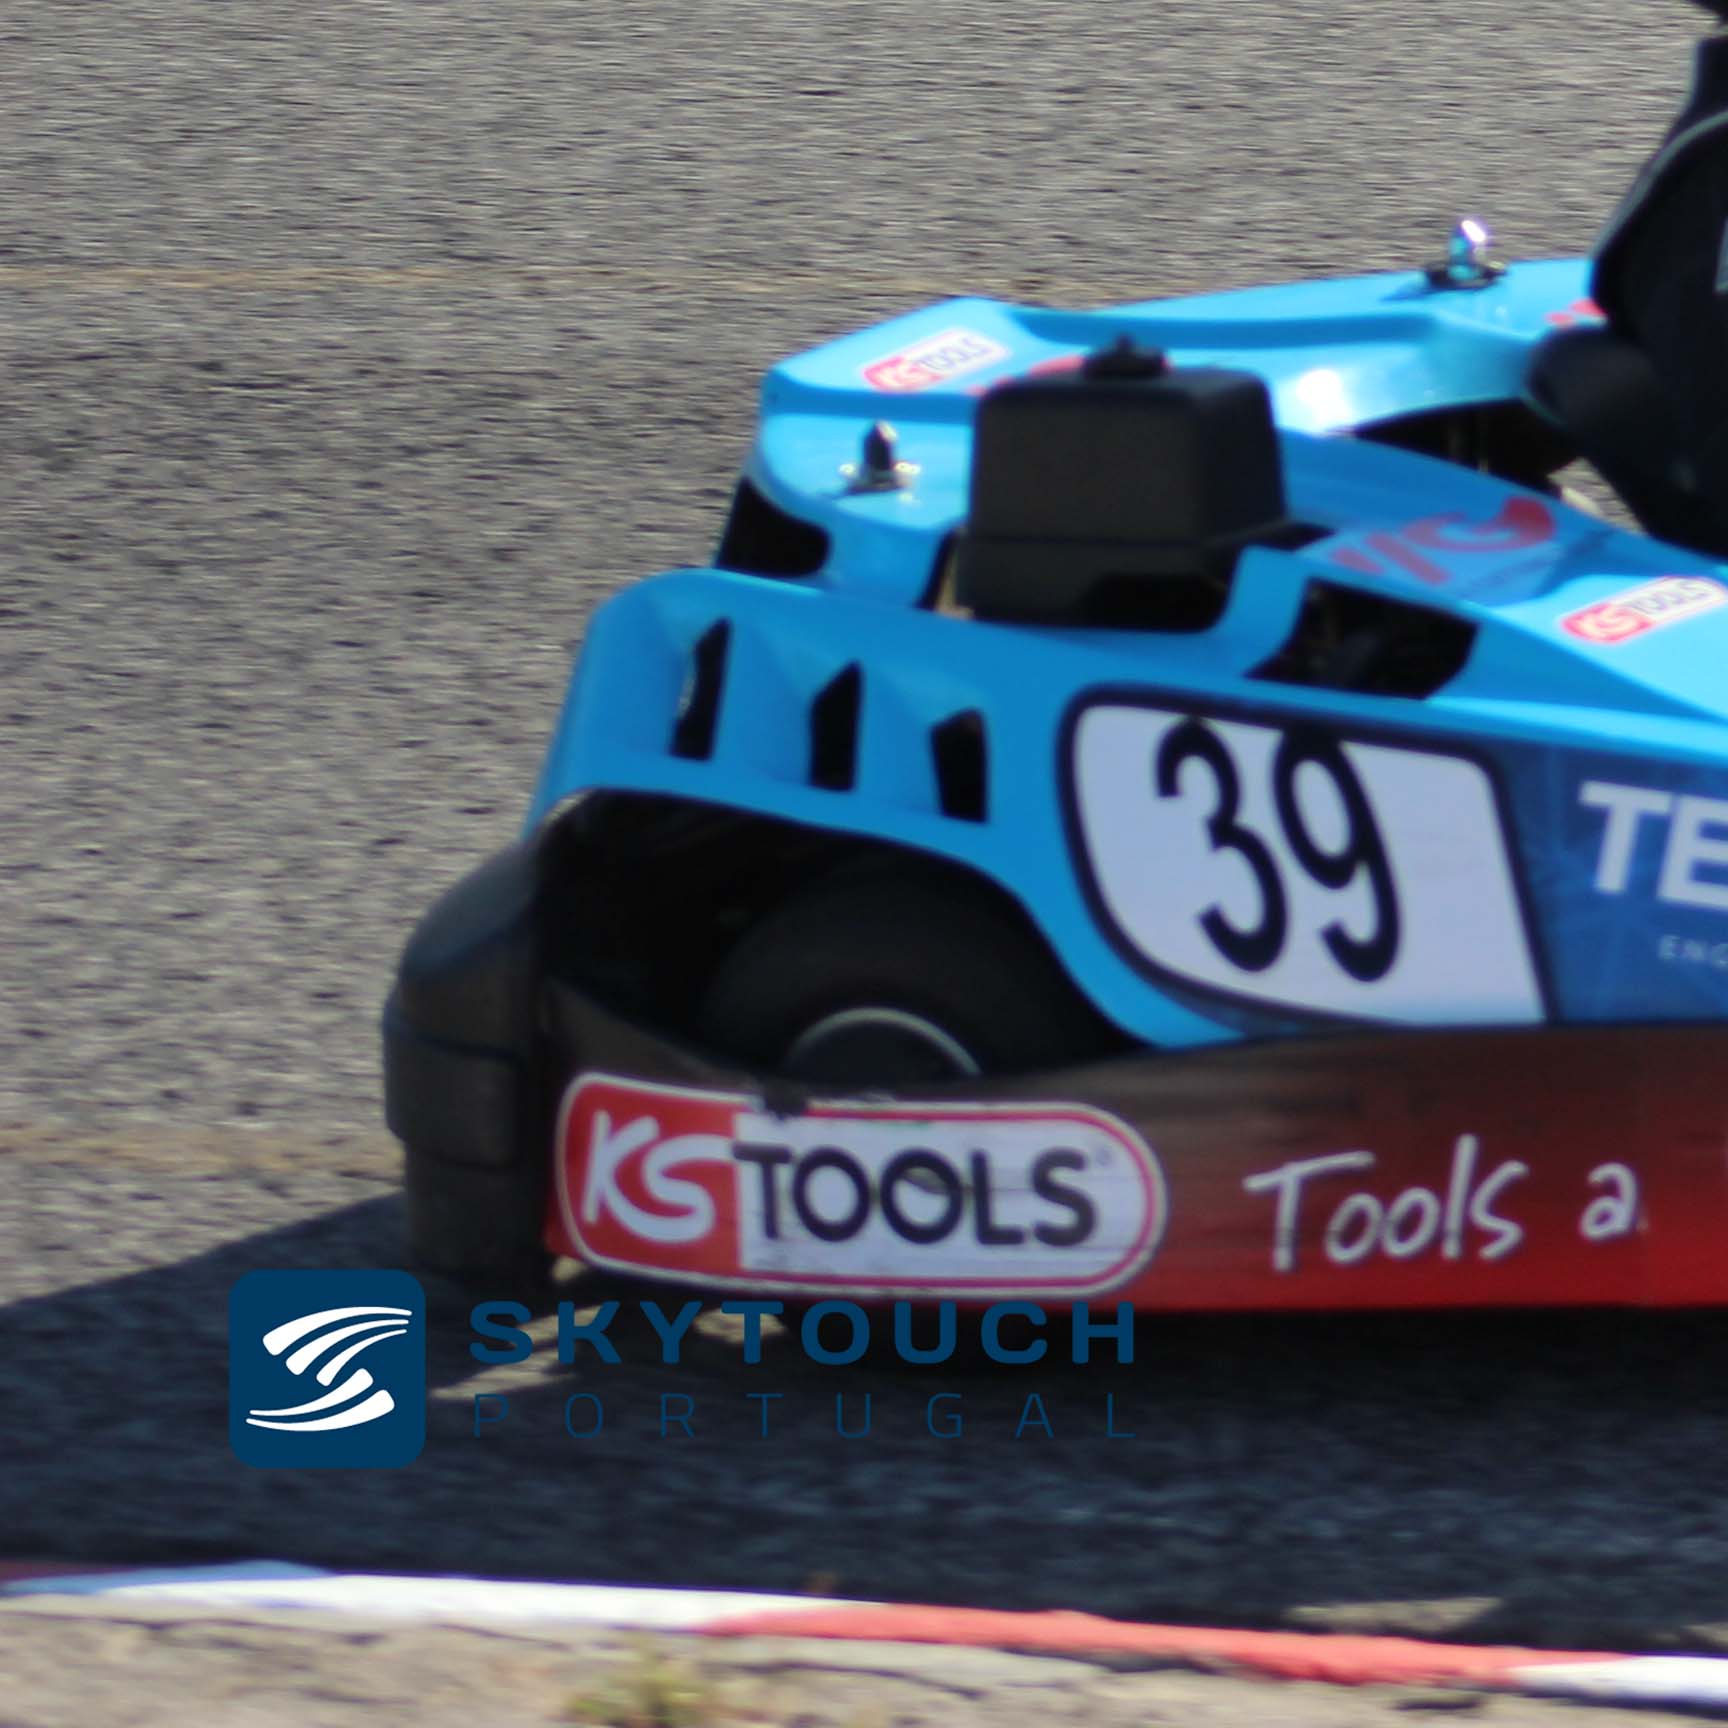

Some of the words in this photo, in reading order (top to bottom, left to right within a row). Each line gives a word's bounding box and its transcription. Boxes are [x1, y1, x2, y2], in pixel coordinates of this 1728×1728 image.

[1155, 713, 1402, 983] 39
[583, 1110, 734, 1243] KS
[732, 1141, 1099, 1247] TOOLS
[1243, 1133, 1530, 1272] Tools
[1579, 1161, 1640, 1241] a
